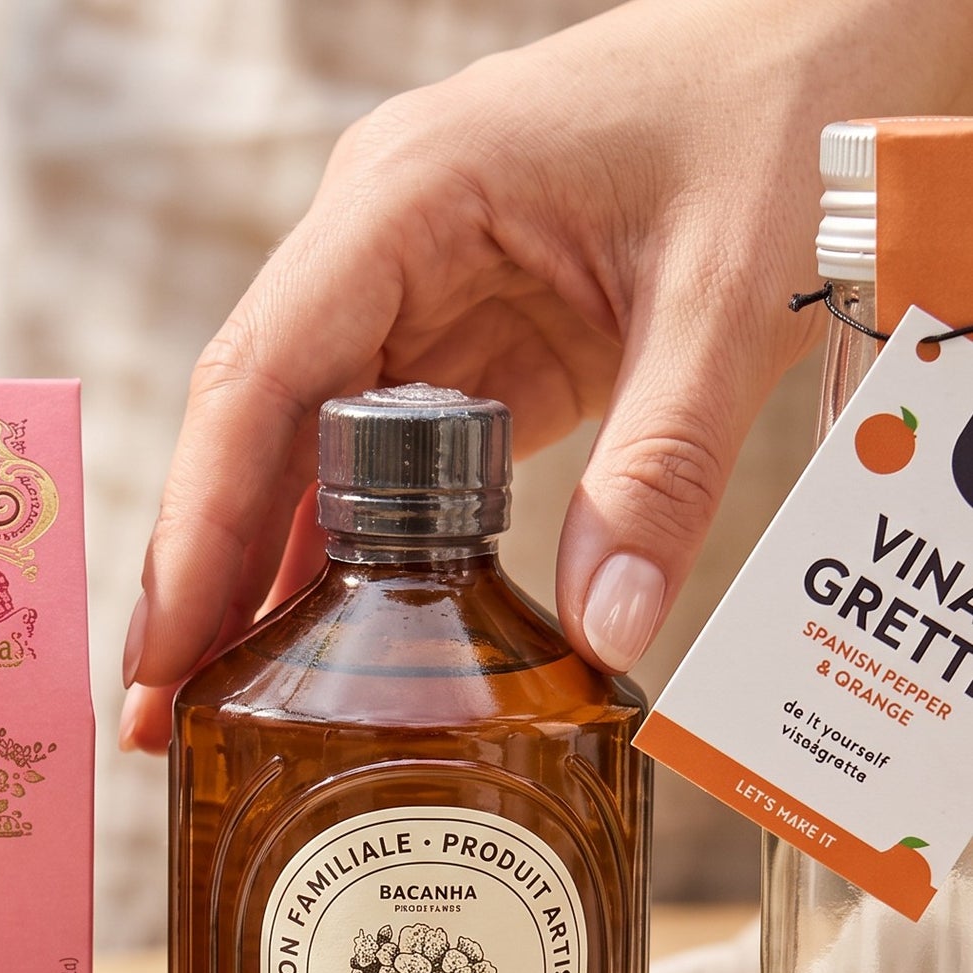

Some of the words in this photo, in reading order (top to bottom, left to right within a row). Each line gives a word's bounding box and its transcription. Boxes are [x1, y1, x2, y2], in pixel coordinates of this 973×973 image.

[804, 558, 973, 698] GRETT
[816, 660, 831, 676] &
[881, 669, 952, 720] PEPPER
[735, 779, 776, 812] LET'S
[776, 805, 819, 839] MAKE
[819, 832, 837, 848] IT
[287, 832, 412, 927] FAMILIALE
[442, 832, 552, 900] PRODUIT
[379, 885, 478, 900] BACANHA
